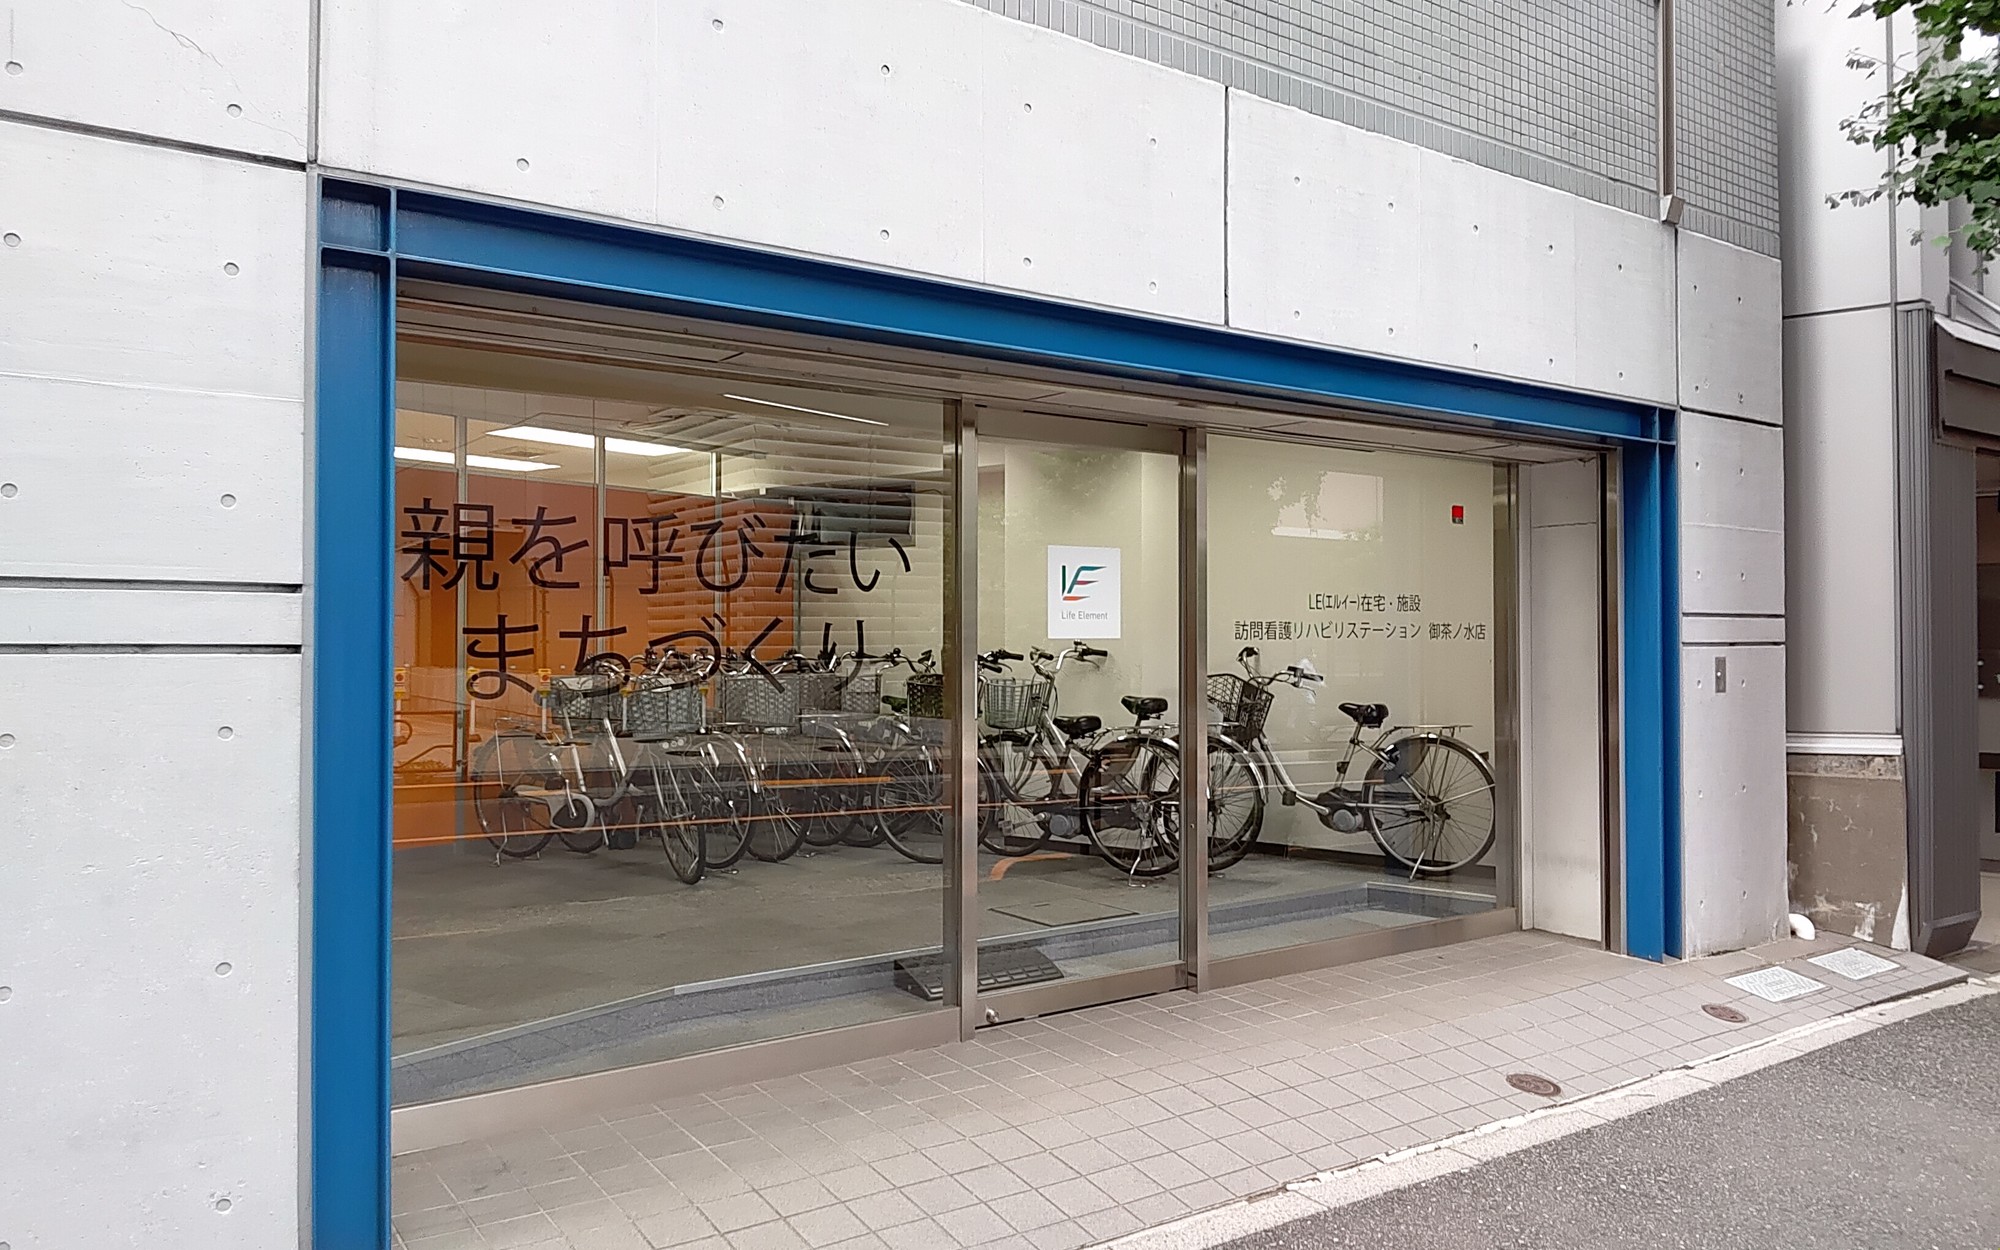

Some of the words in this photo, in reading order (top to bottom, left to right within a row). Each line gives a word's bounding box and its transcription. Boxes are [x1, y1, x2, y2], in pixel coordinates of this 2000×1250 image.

[401, 497, 912, 595] 親を呼びたい
[1061, 610, 1076, 620] Life
[1078, 610, 1108, 620] Element
[1234, 620, 1421, 640] 訪問看護リハビリステーション
[1428, 622, 1486, 641] 御茶ノ水店
[462, 612, 866, 700] まちづくり
